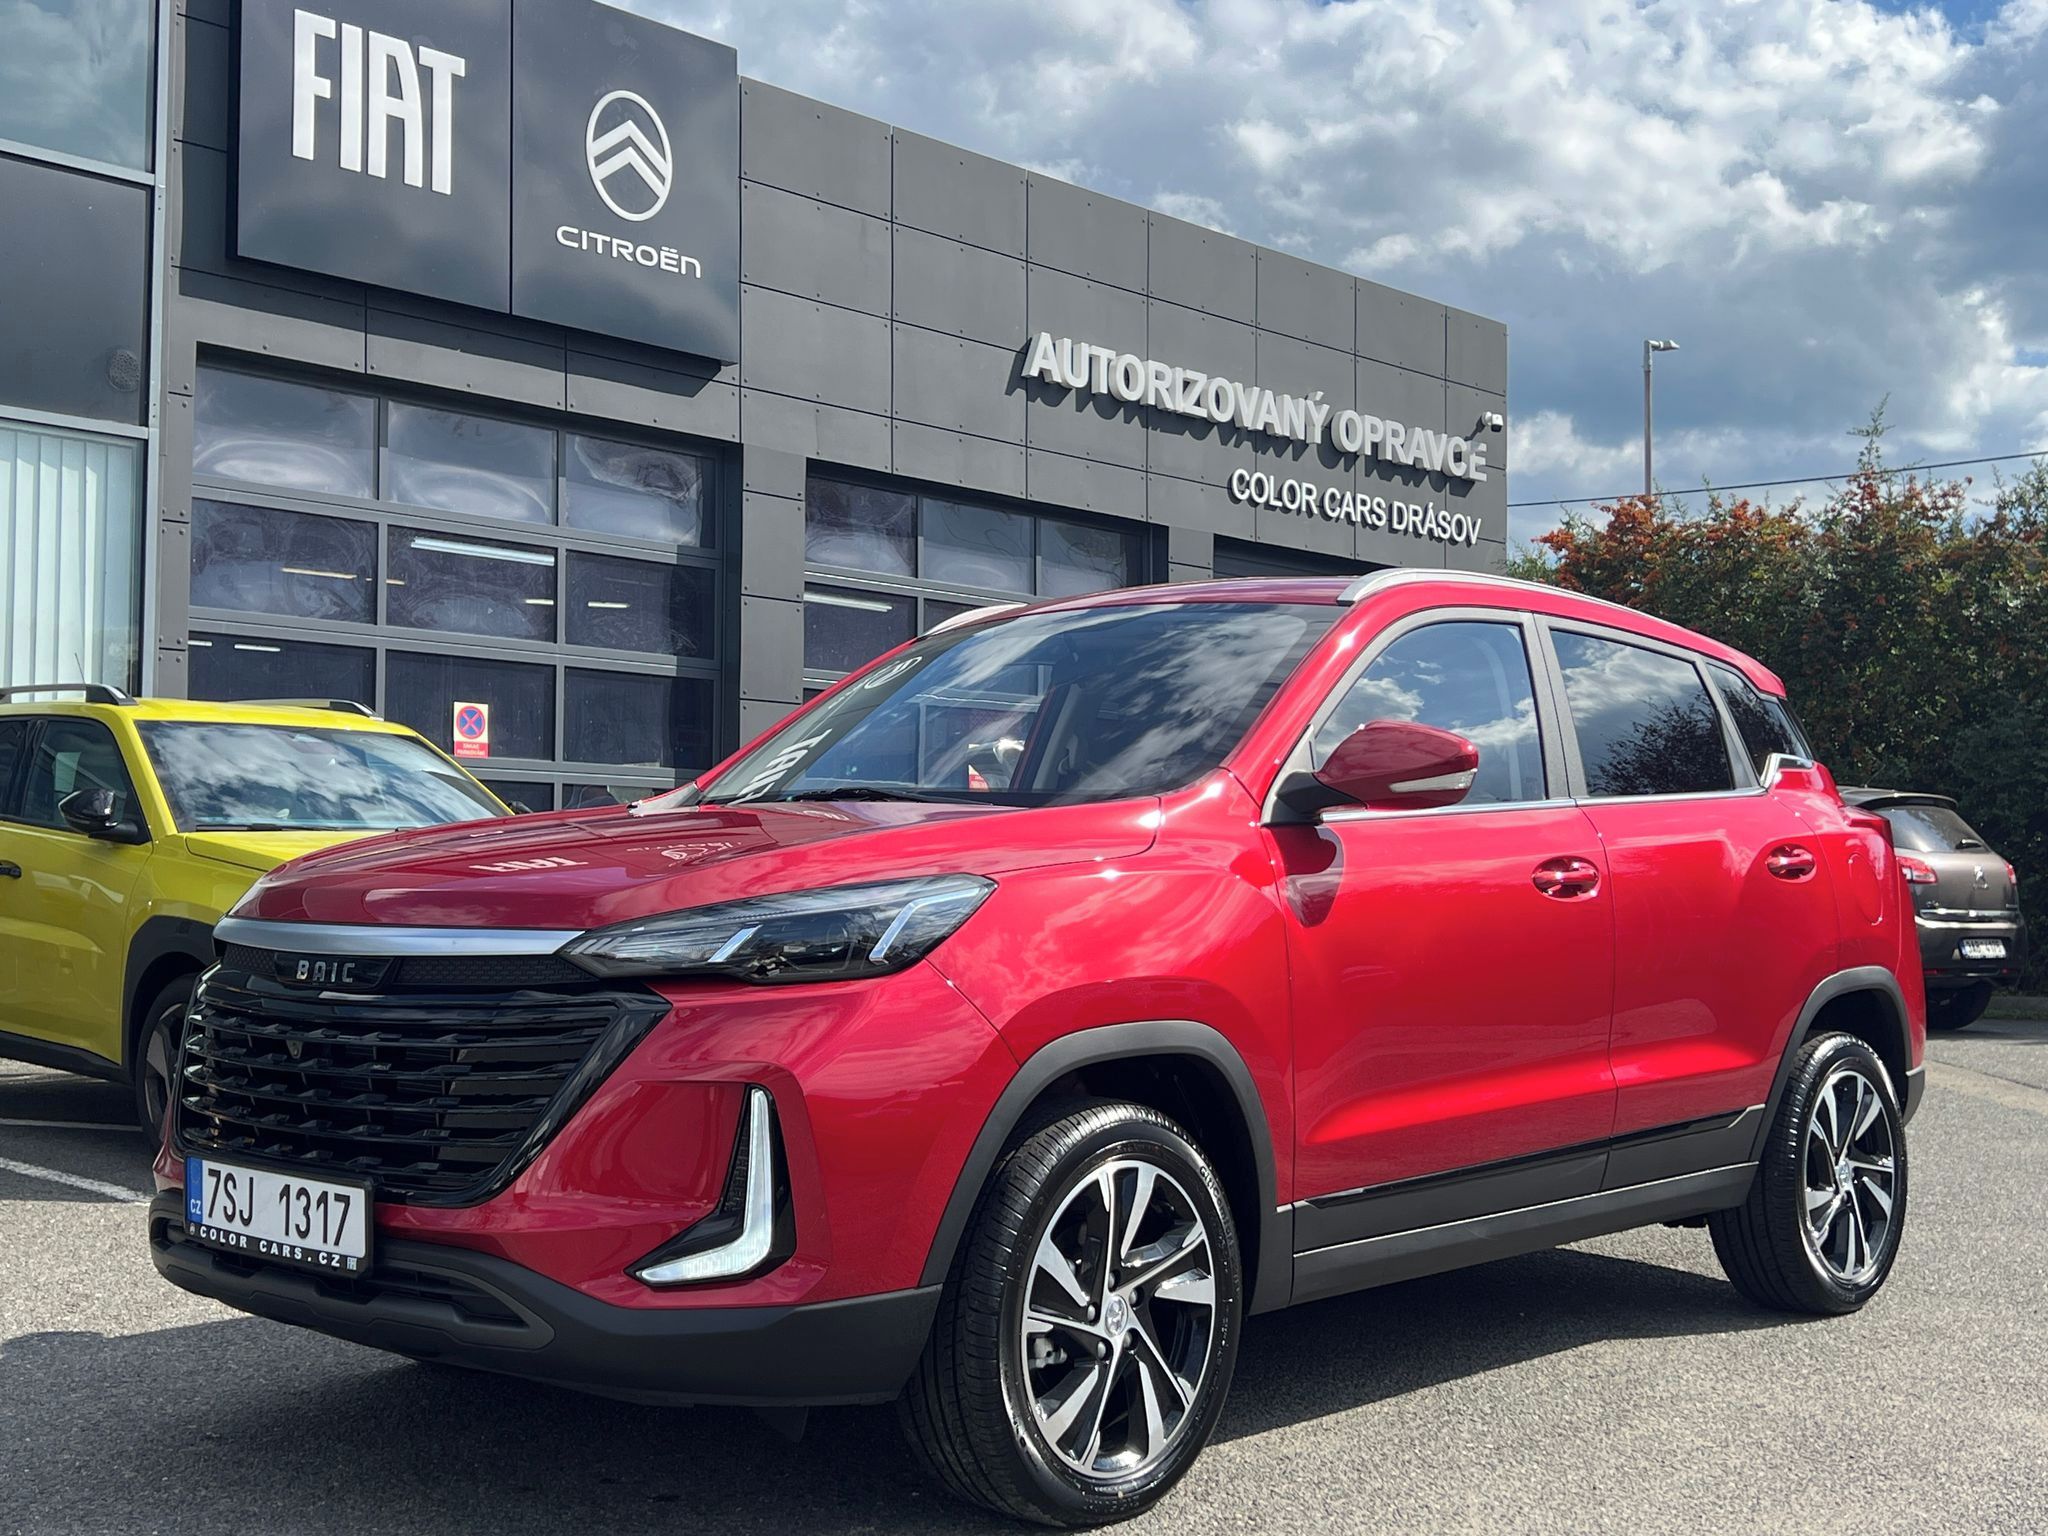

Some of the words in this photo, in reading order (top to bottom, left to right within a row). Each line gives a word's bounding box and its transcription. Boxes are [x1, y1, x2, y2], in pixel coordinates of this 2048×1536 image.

[292, 9, 465, 196] FIAT
[1022, 331, 1330, 445] AUTORIZOVANÝ
[1331, 409, 1488, 483] OPRAVCÉ
[1231, 467, 1319, 516] COLOR
[1324, 487, 1388, 529] CARS
[1393, 501, 1483, 546] DRÁSOV
[296, 959, 356, 983] BAIC
[190, 1198, 201, 1215] CZ
[207, 1167, 254, 1227] 7SJ
[279, 1183, 351, 1247] 1317
[200, 1225, 247, 1249] COLOR
[259, 1239, 341, 1268] CARS.CZ
